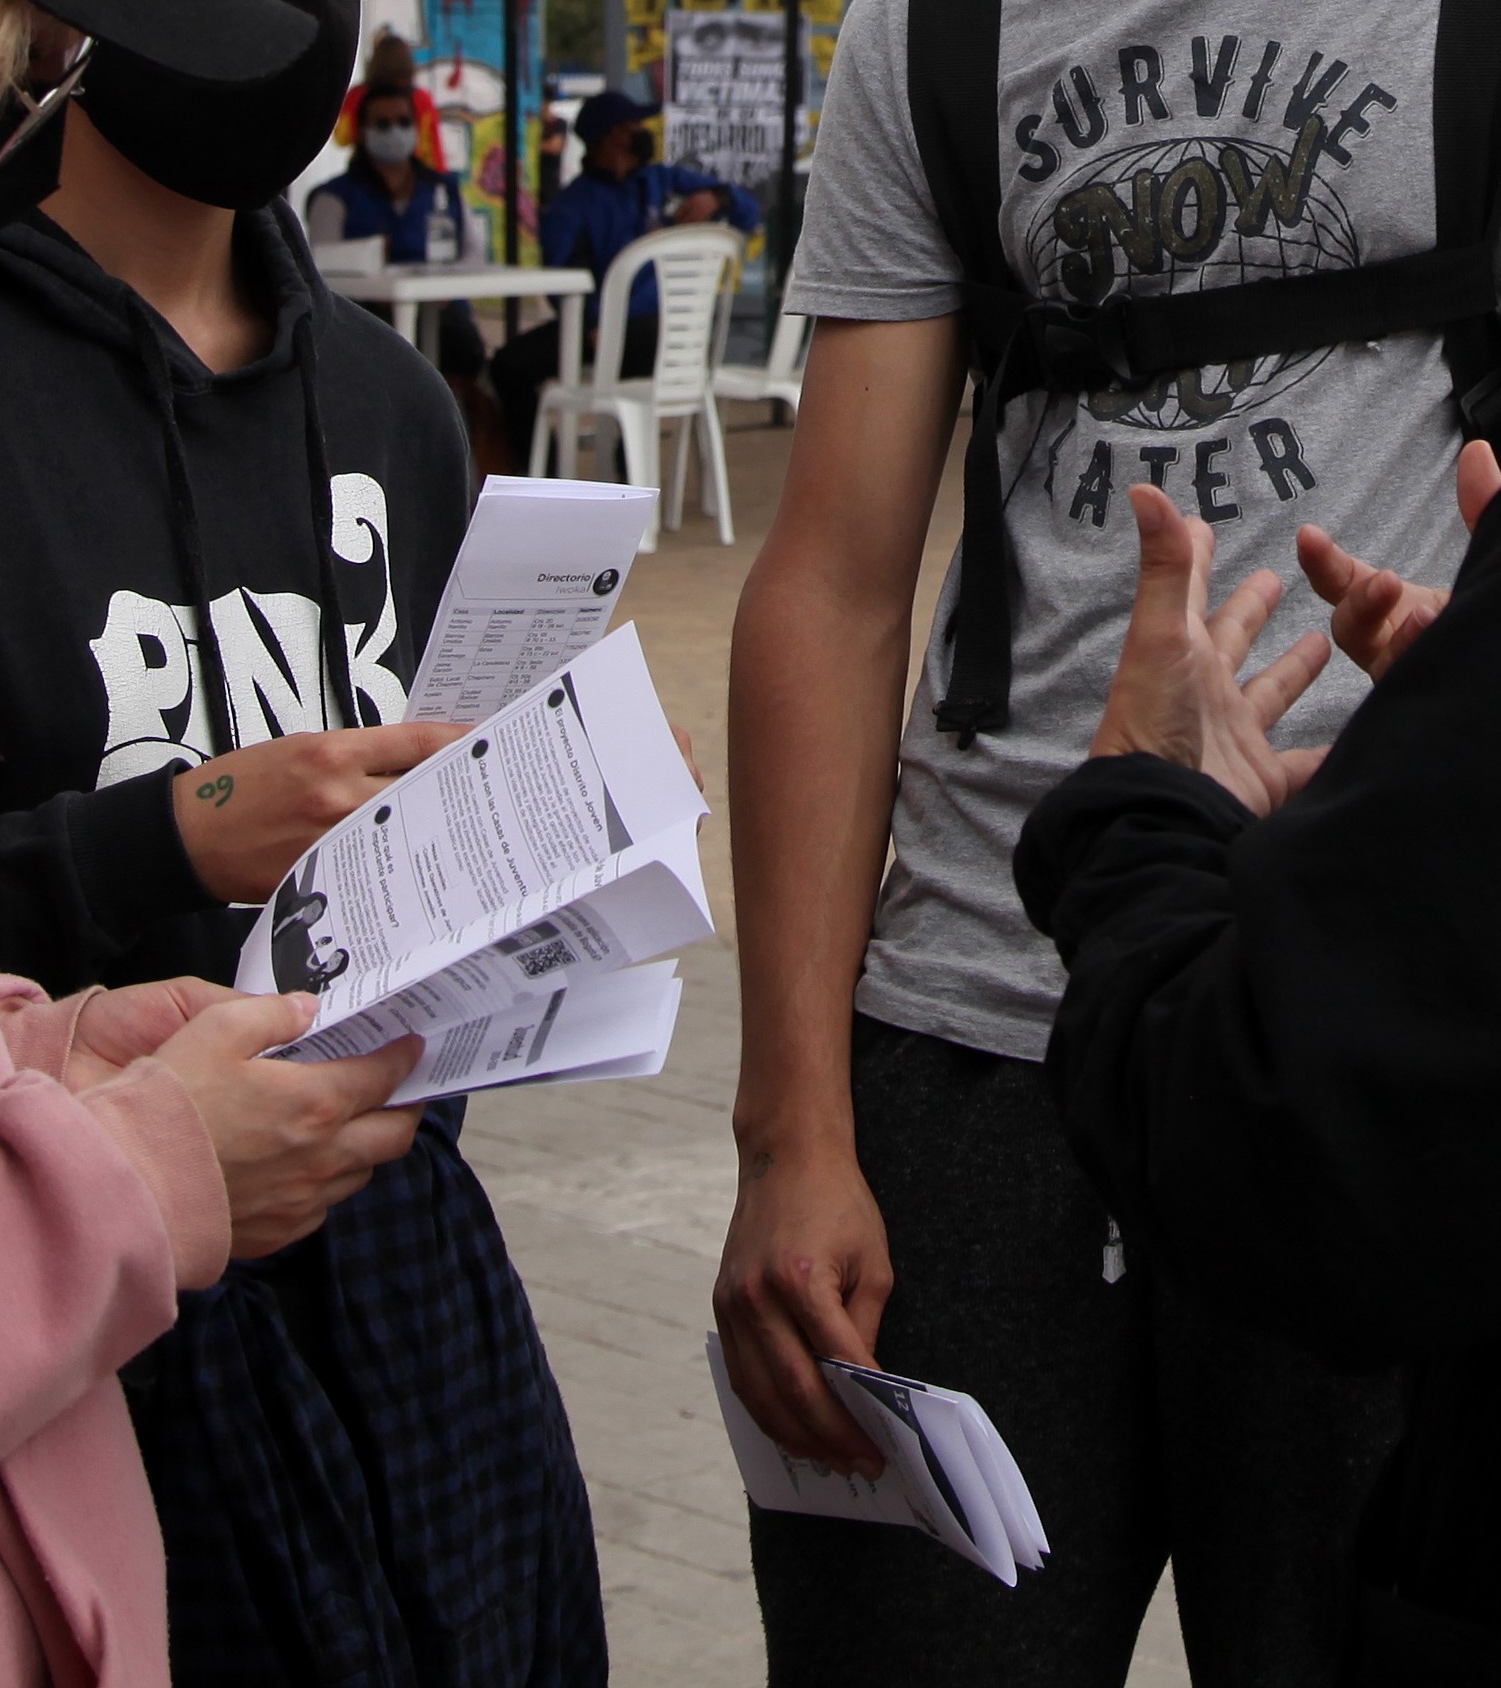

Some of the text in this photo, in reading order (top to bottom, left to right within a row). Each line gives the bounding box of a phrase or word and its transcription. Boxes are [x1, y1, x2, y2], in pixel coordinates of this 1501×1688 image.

[1014, 35, 1398, 183] SURVIVE
[1053, 114, 1326, 301] NOW
[537, 572, 592, 583] Directorio
[477, 758, 489, 780] ¿Qué
[554, 707, 604, 832] El proyecto Distrito Joven
[482, 781, 491, 798] son
[487, 796, 495, 812] las
[490, 811, 506, 840] Casas
[372, 829, 385, 878] importante
[380, 823, 394, 874] ¿Por qué es
[500, 840, 510, 854] de
[378, 877, 400, 929] participar?
[891, 1390, 910, 1411] 12
